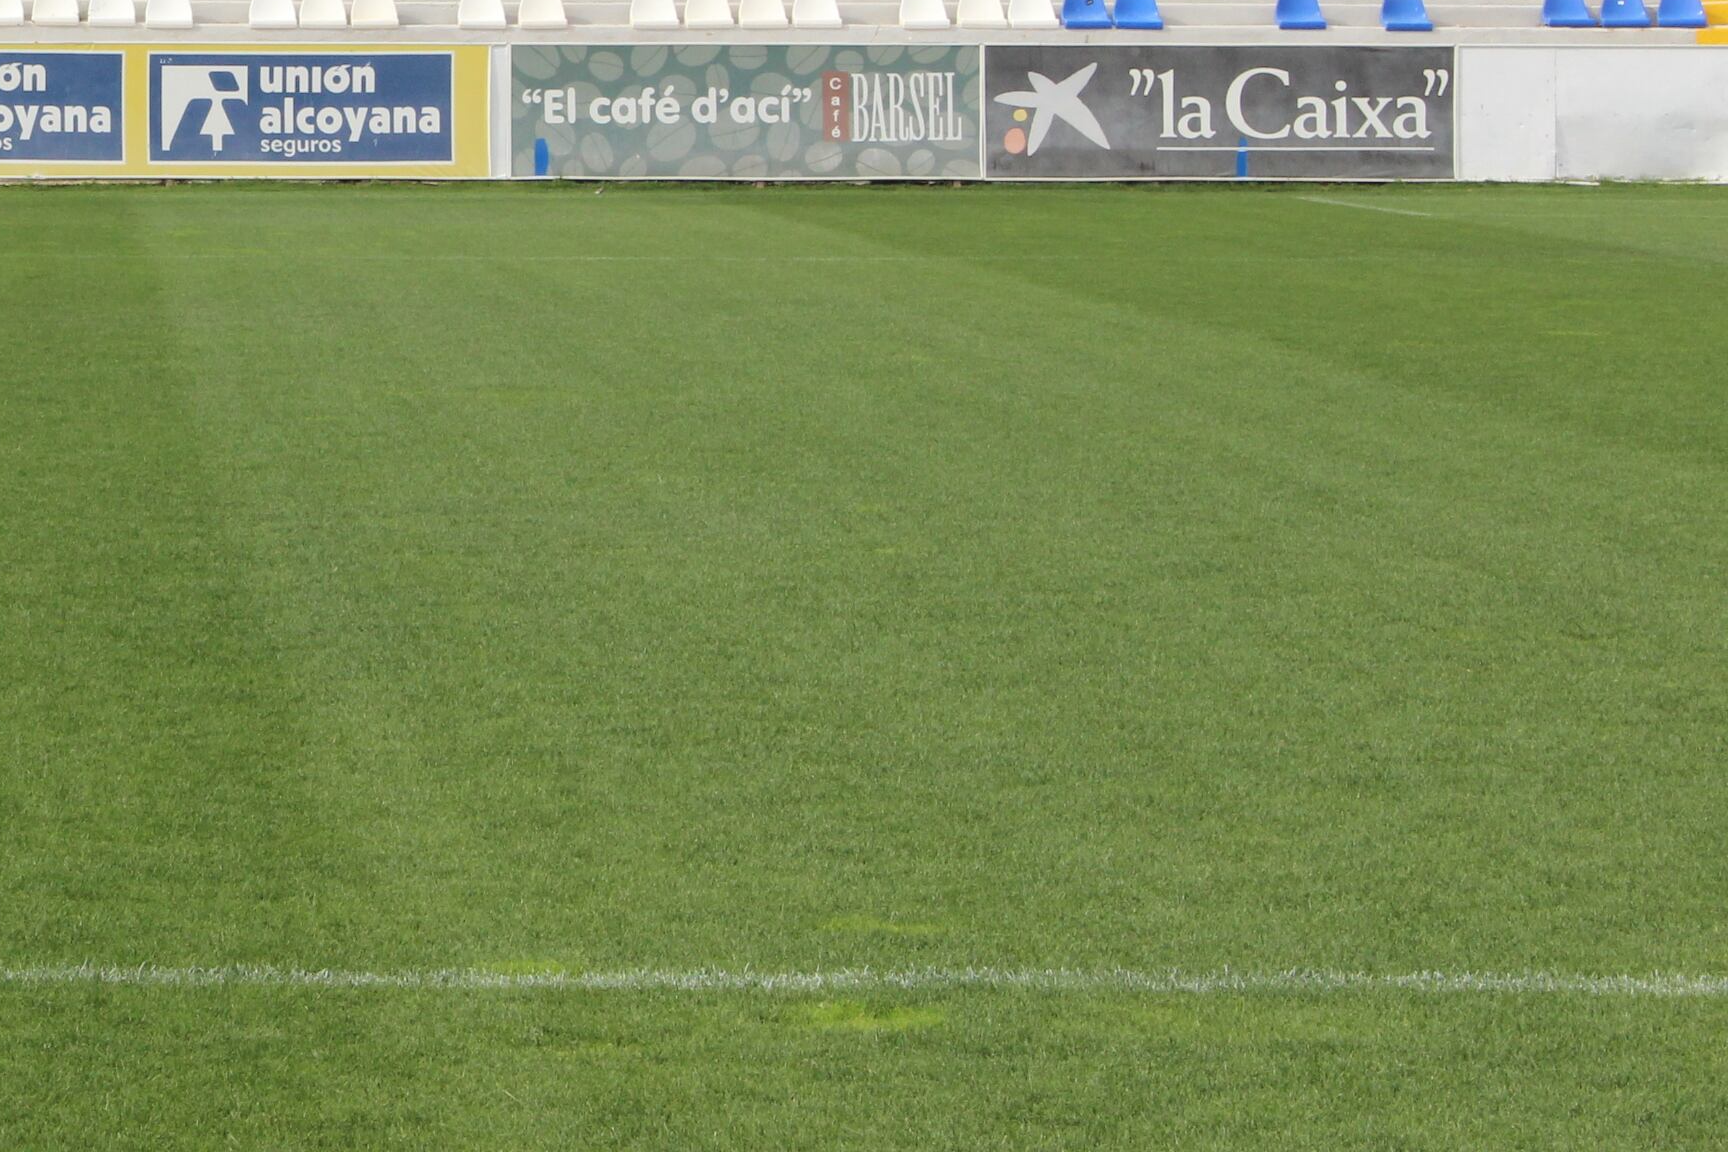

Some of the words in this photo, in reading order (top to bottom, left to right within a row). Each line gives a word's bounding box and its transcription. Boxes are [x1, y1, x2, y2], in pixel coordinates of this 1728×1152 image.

[260, 97, 441, 141] alcoyana
[589, 85, 680, 124] café
[851, 72, 962, 142] BARSEL
[260, 138, 342, 156] seguros
